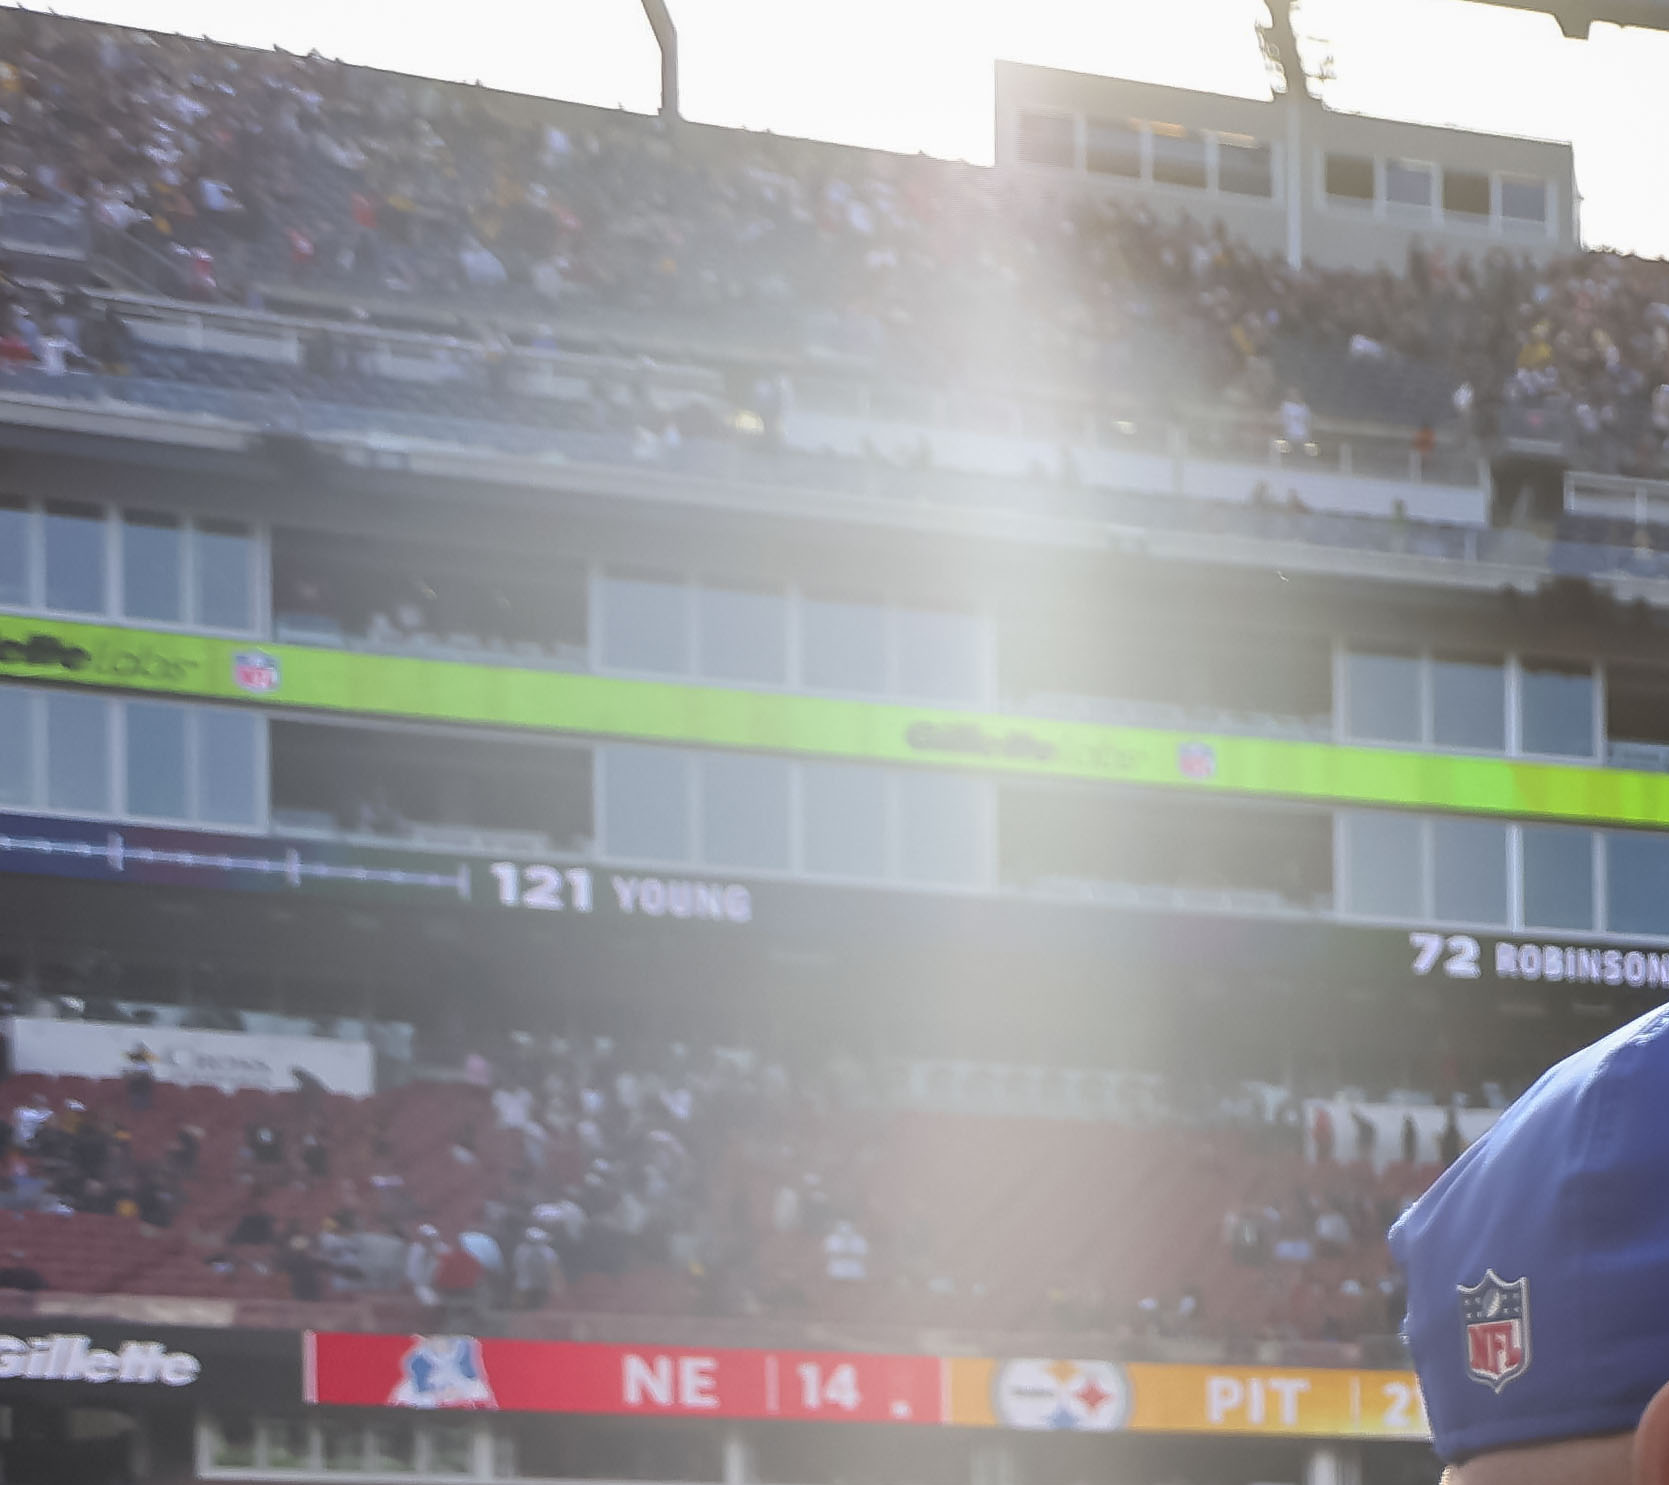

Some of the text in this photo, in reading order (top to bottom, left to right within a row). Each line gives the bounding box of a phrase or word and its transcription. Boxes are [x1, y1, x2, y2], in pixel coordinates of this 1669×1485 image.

[490, 861, 753, 923] 121 YOUNG
[1407, 932, 1482, 978] 72
[623, 1354, 861, 1411] NE 14
[1209, 1376, 1309, 1424] PIT
